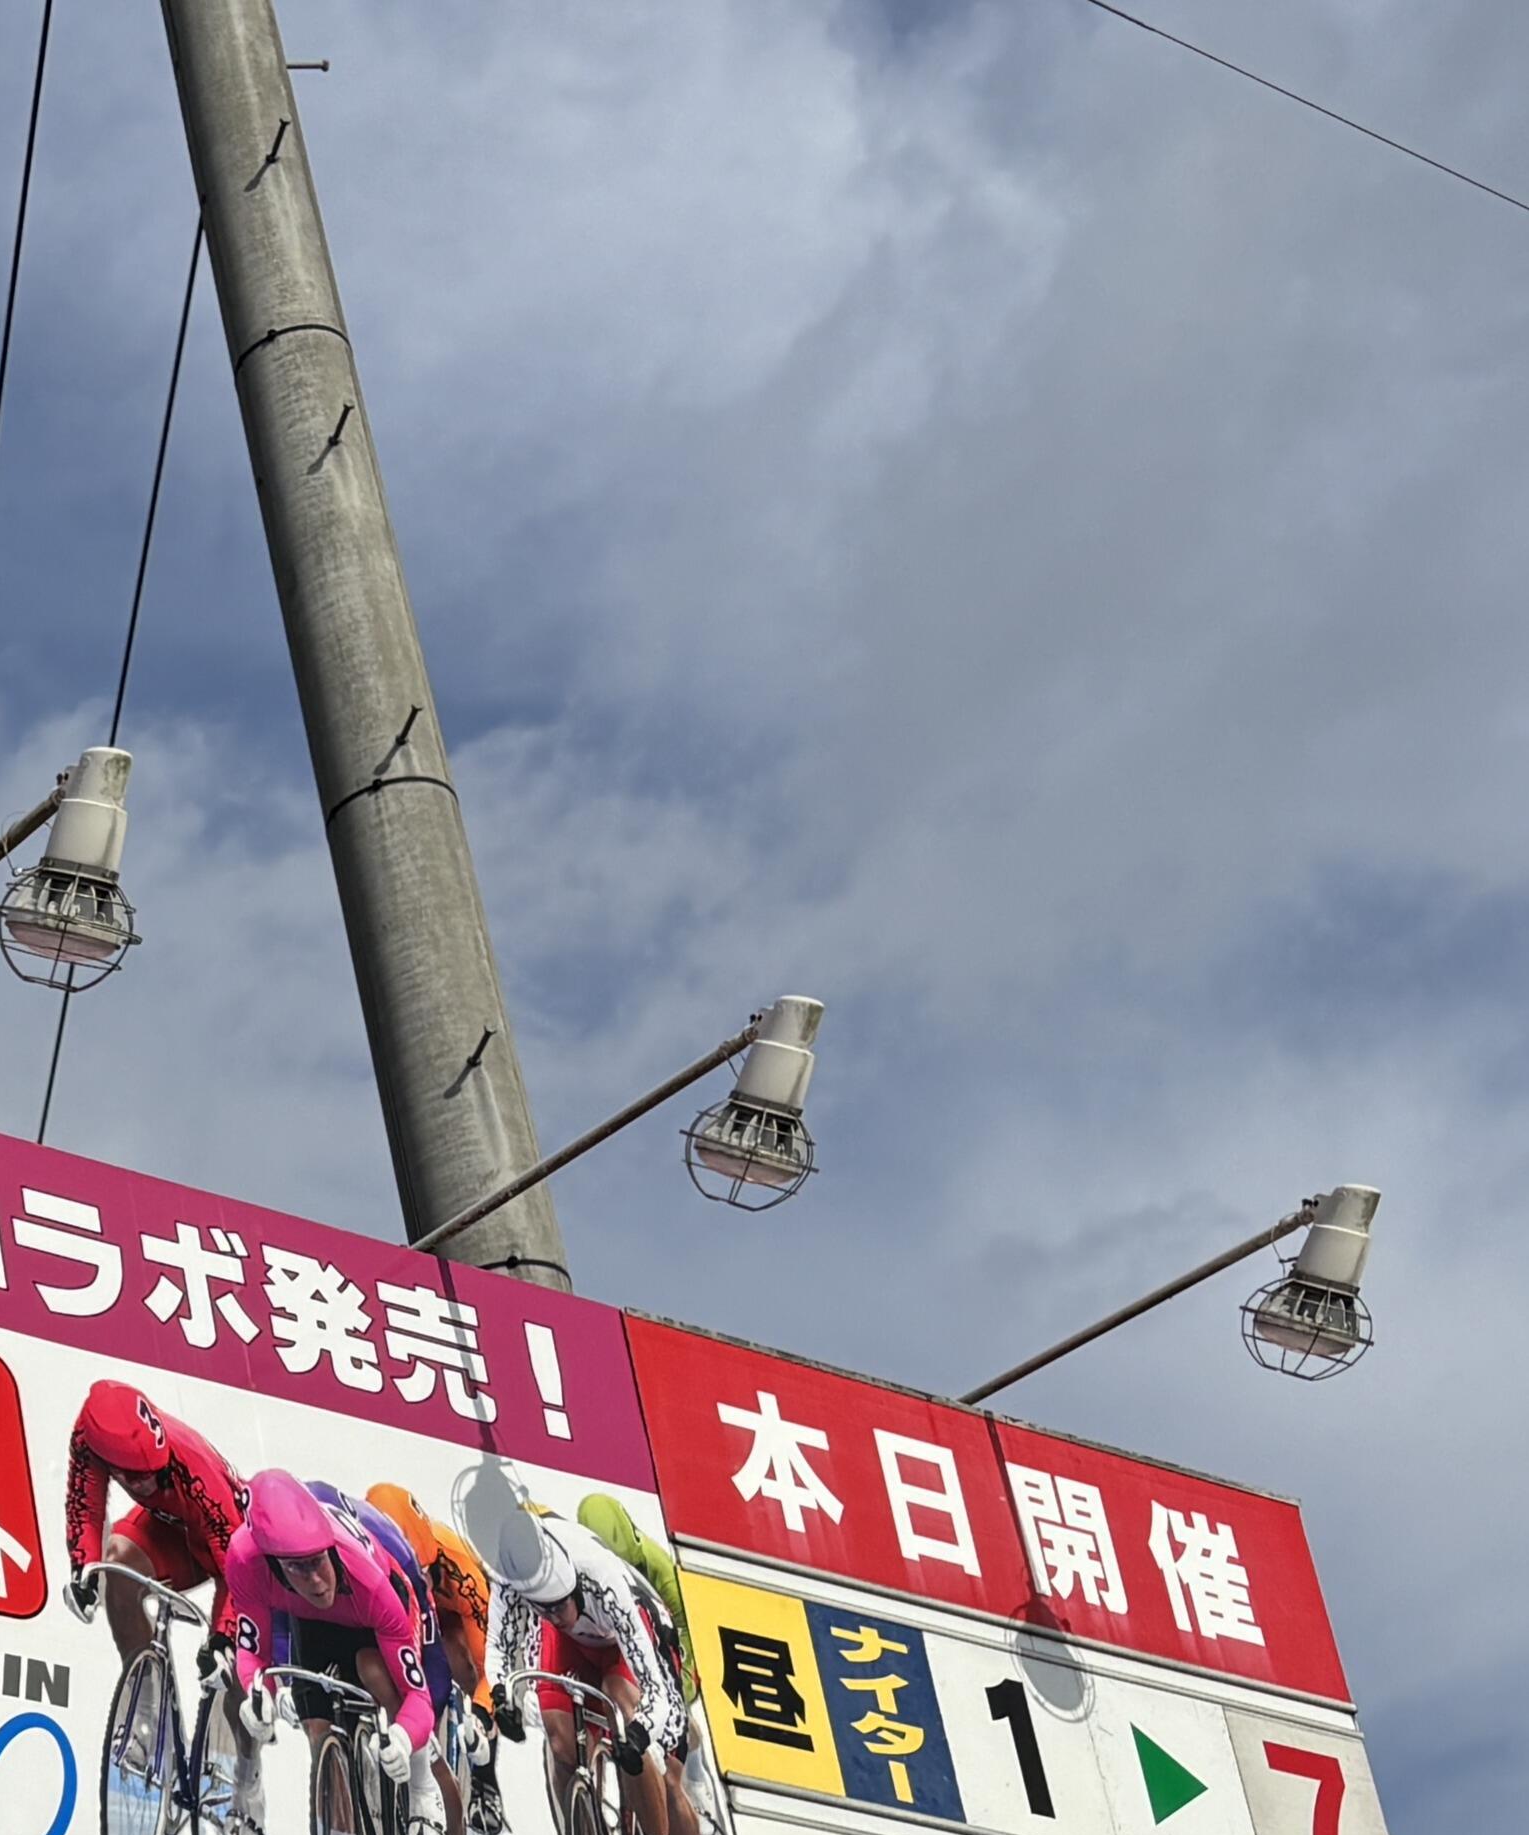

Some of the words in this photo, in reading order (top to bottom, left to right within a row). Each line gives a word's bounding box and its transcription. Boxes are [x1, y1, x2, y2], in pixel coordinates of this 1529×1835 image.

[716, 1391, 1266, 1648] 本日開催
[398, 1645, 426, 1690] 8
[718, 1626, 816, 1752] 昼
[830, 1625, 926, 1804] ナイター
[984, 1677, 1057, 1820] 1
